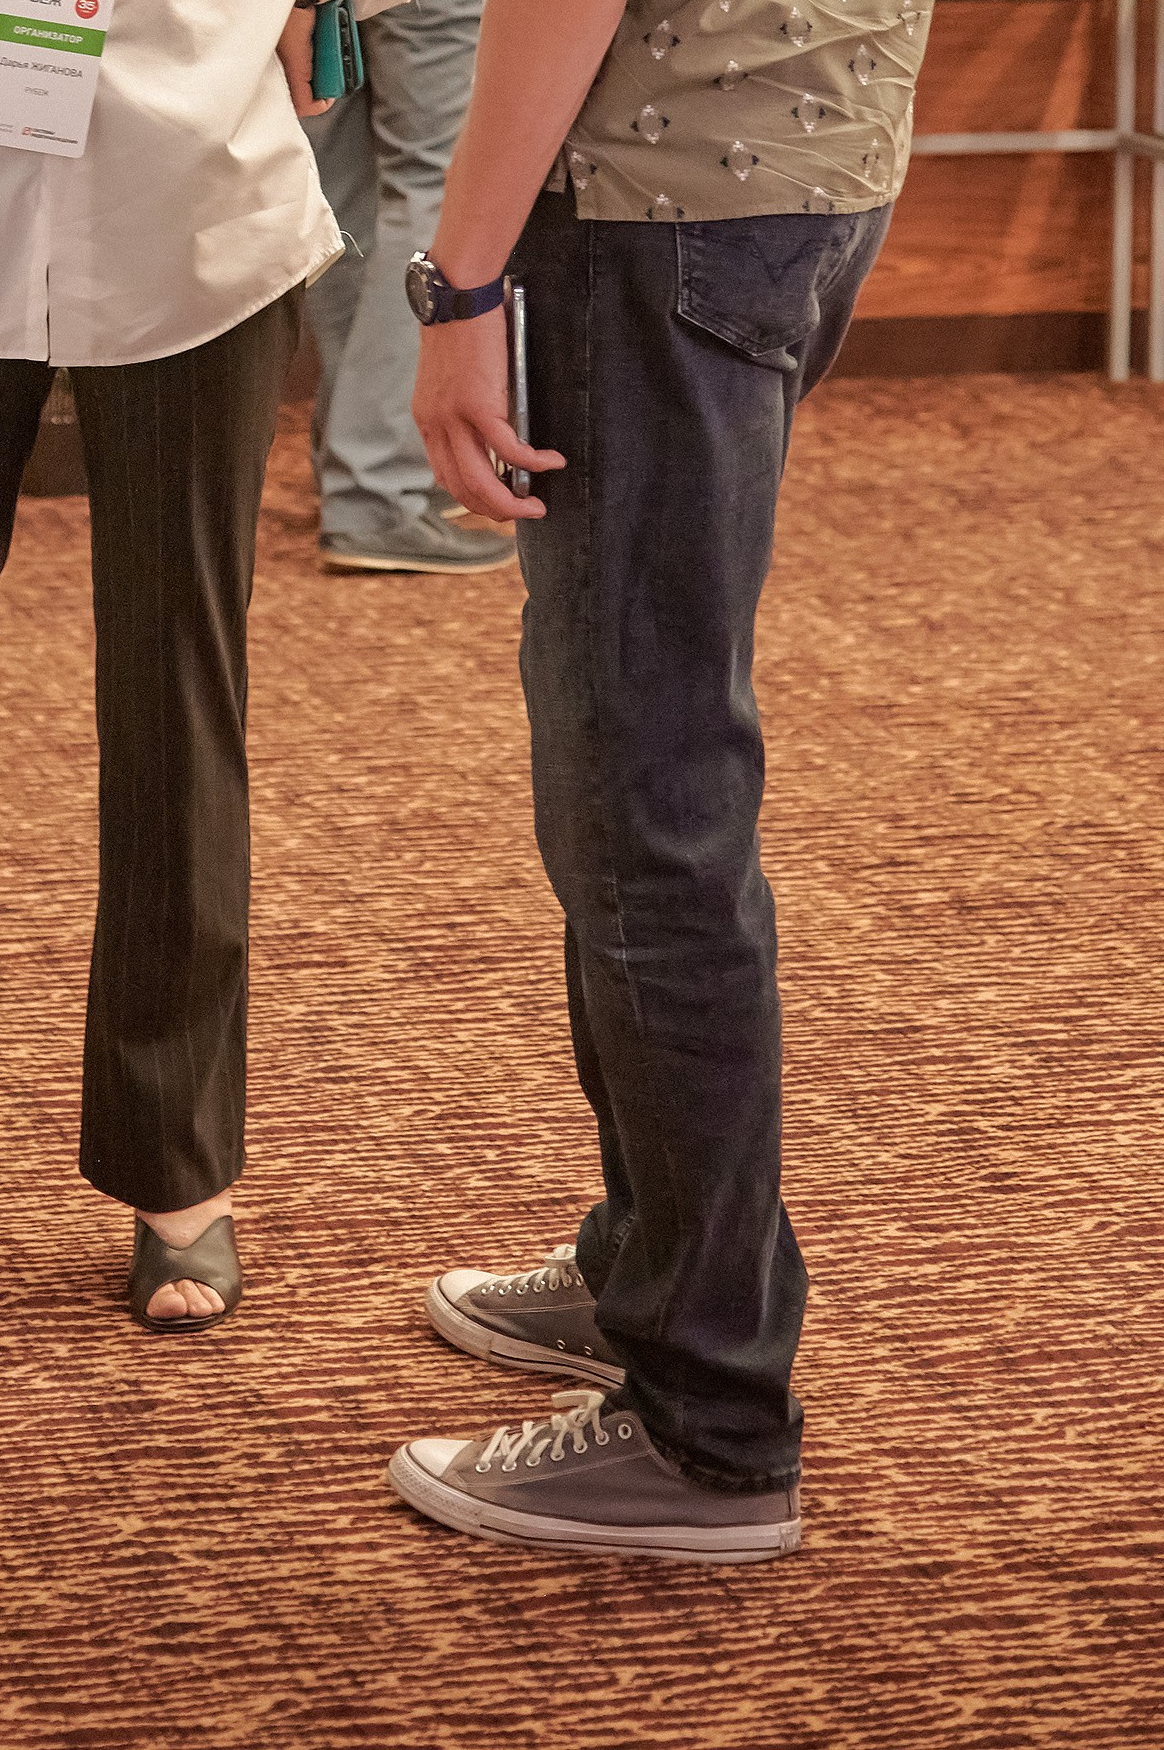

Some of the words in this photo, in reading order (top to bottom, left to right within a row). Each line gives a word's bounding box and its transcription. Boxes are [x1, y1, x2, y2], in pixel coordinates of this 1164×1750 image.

[77, 0, 97, 12] 35
[13, 25, 84, 44] ОРГАНИЗАТОР
[0, 56, 29, 70] Дарья
[30, 61, 83, 78] ЖИГАНОВА
